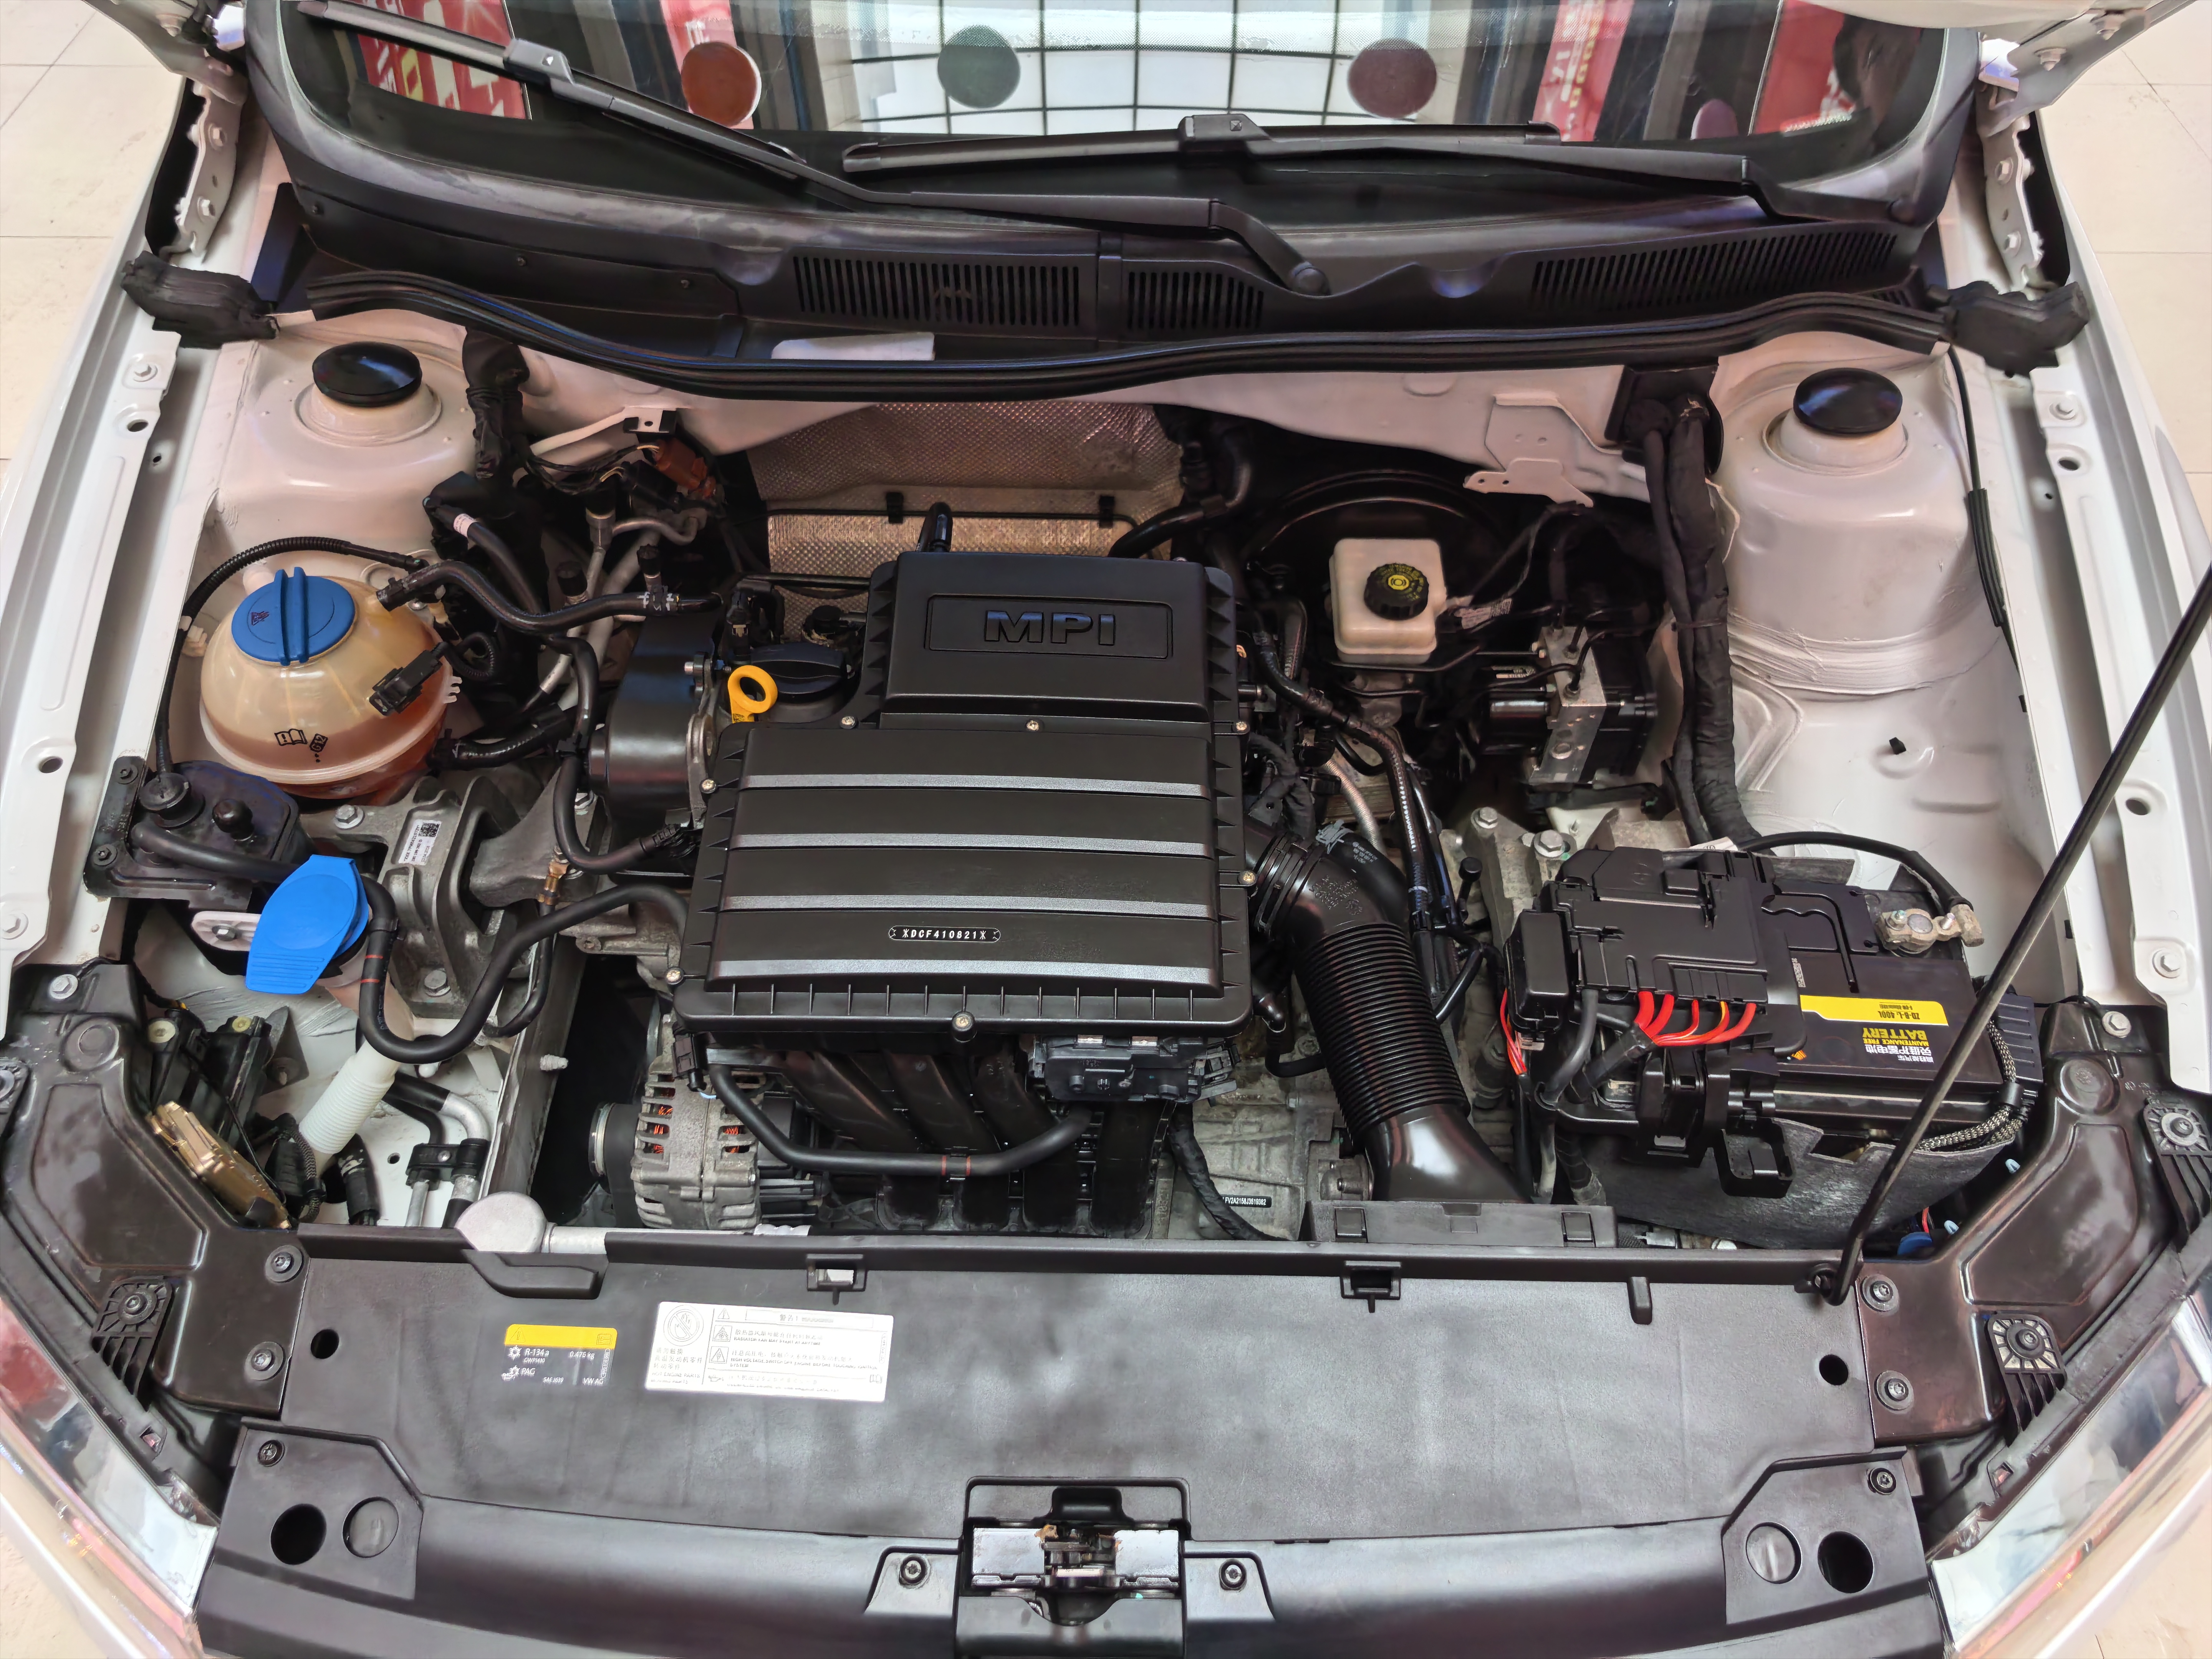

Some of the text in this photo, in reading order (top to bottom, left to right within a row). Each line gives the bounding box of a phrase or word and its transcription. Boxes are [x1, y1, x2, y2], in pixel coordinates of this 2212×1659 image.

[985, 610, 1115, 646] MPI
[1862, 1028, 1927, 1041] BATTERY
[588, 1351, 595, 1360] kg
